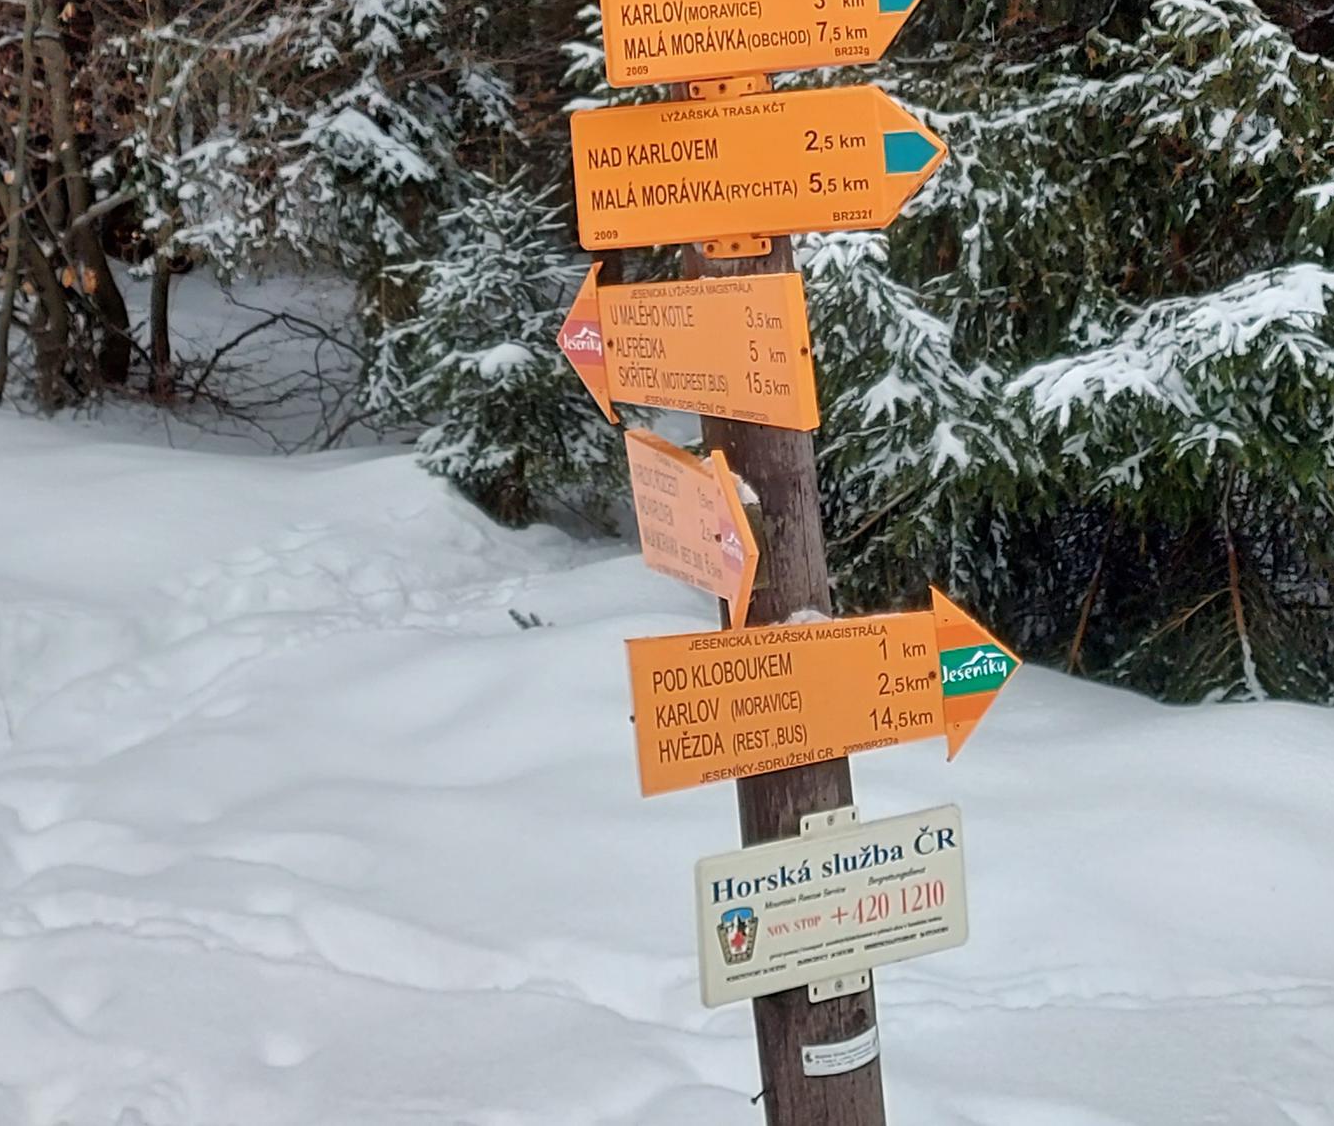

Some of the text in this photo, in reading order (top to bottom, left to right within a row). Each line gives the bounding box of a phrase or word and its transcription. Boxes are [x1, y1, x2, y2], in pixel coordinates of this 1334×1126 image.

[624, 21, 868, 60] MALÁ 7,5 km
[834, 46, 870, 57] BR232g
[626, 65, 649, 76] 2009
[660, 102, 786, 123] LYŽAŘSKÁ TRASA KČT
[588, 131, 866, 170] NAD KARLOVEM 2,5 km
[591, 172, 869, 211] MALÁ 5,5 km
[594, 229, 619, 241] 2009
[610, 301, 694, 328] U MALÉHO KOTLE
[616, 334, 787, 363] ALFRÉDKA 5 km
[688, 624, 888, 651] JESENICKÁ LYŽAŘSKÁ MAGISTRÁLA
[653, 639, 927, 695] POD KLOBOUKEM 1 km
[941, 657, 1008, 683] Jeseníky
[655, 690, 803, 729] KARLOV (MORAVICE)
[658, 731, 724, 763] HVĚZDA
[711, 824, 957, 905] Horská služba ČR
[793, 916, 821, 934] STOP
[900, 879, 945, 915] 1210
